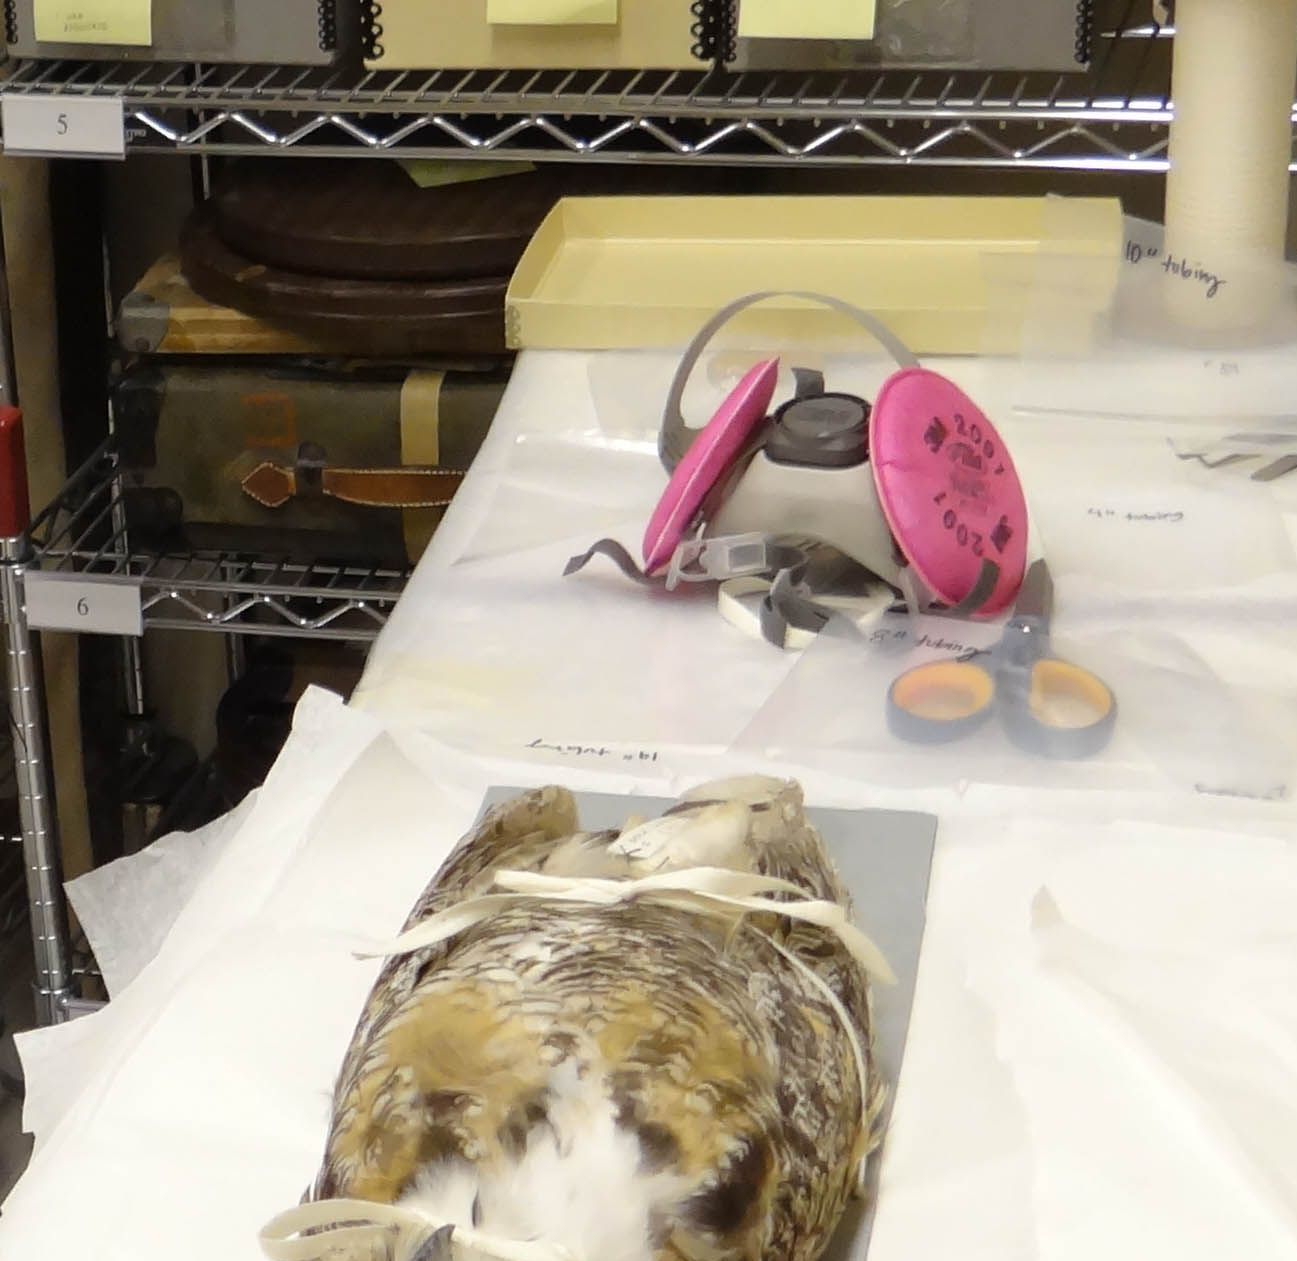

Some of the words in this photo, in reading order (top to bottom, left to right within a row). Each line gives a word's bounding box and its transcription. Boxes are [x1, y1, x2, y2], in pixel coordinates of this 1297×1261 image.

[56, 113, 68, 135] 5
[1161, 253, 1227, 299] tubing
[76, 597, 89, 616] 6
